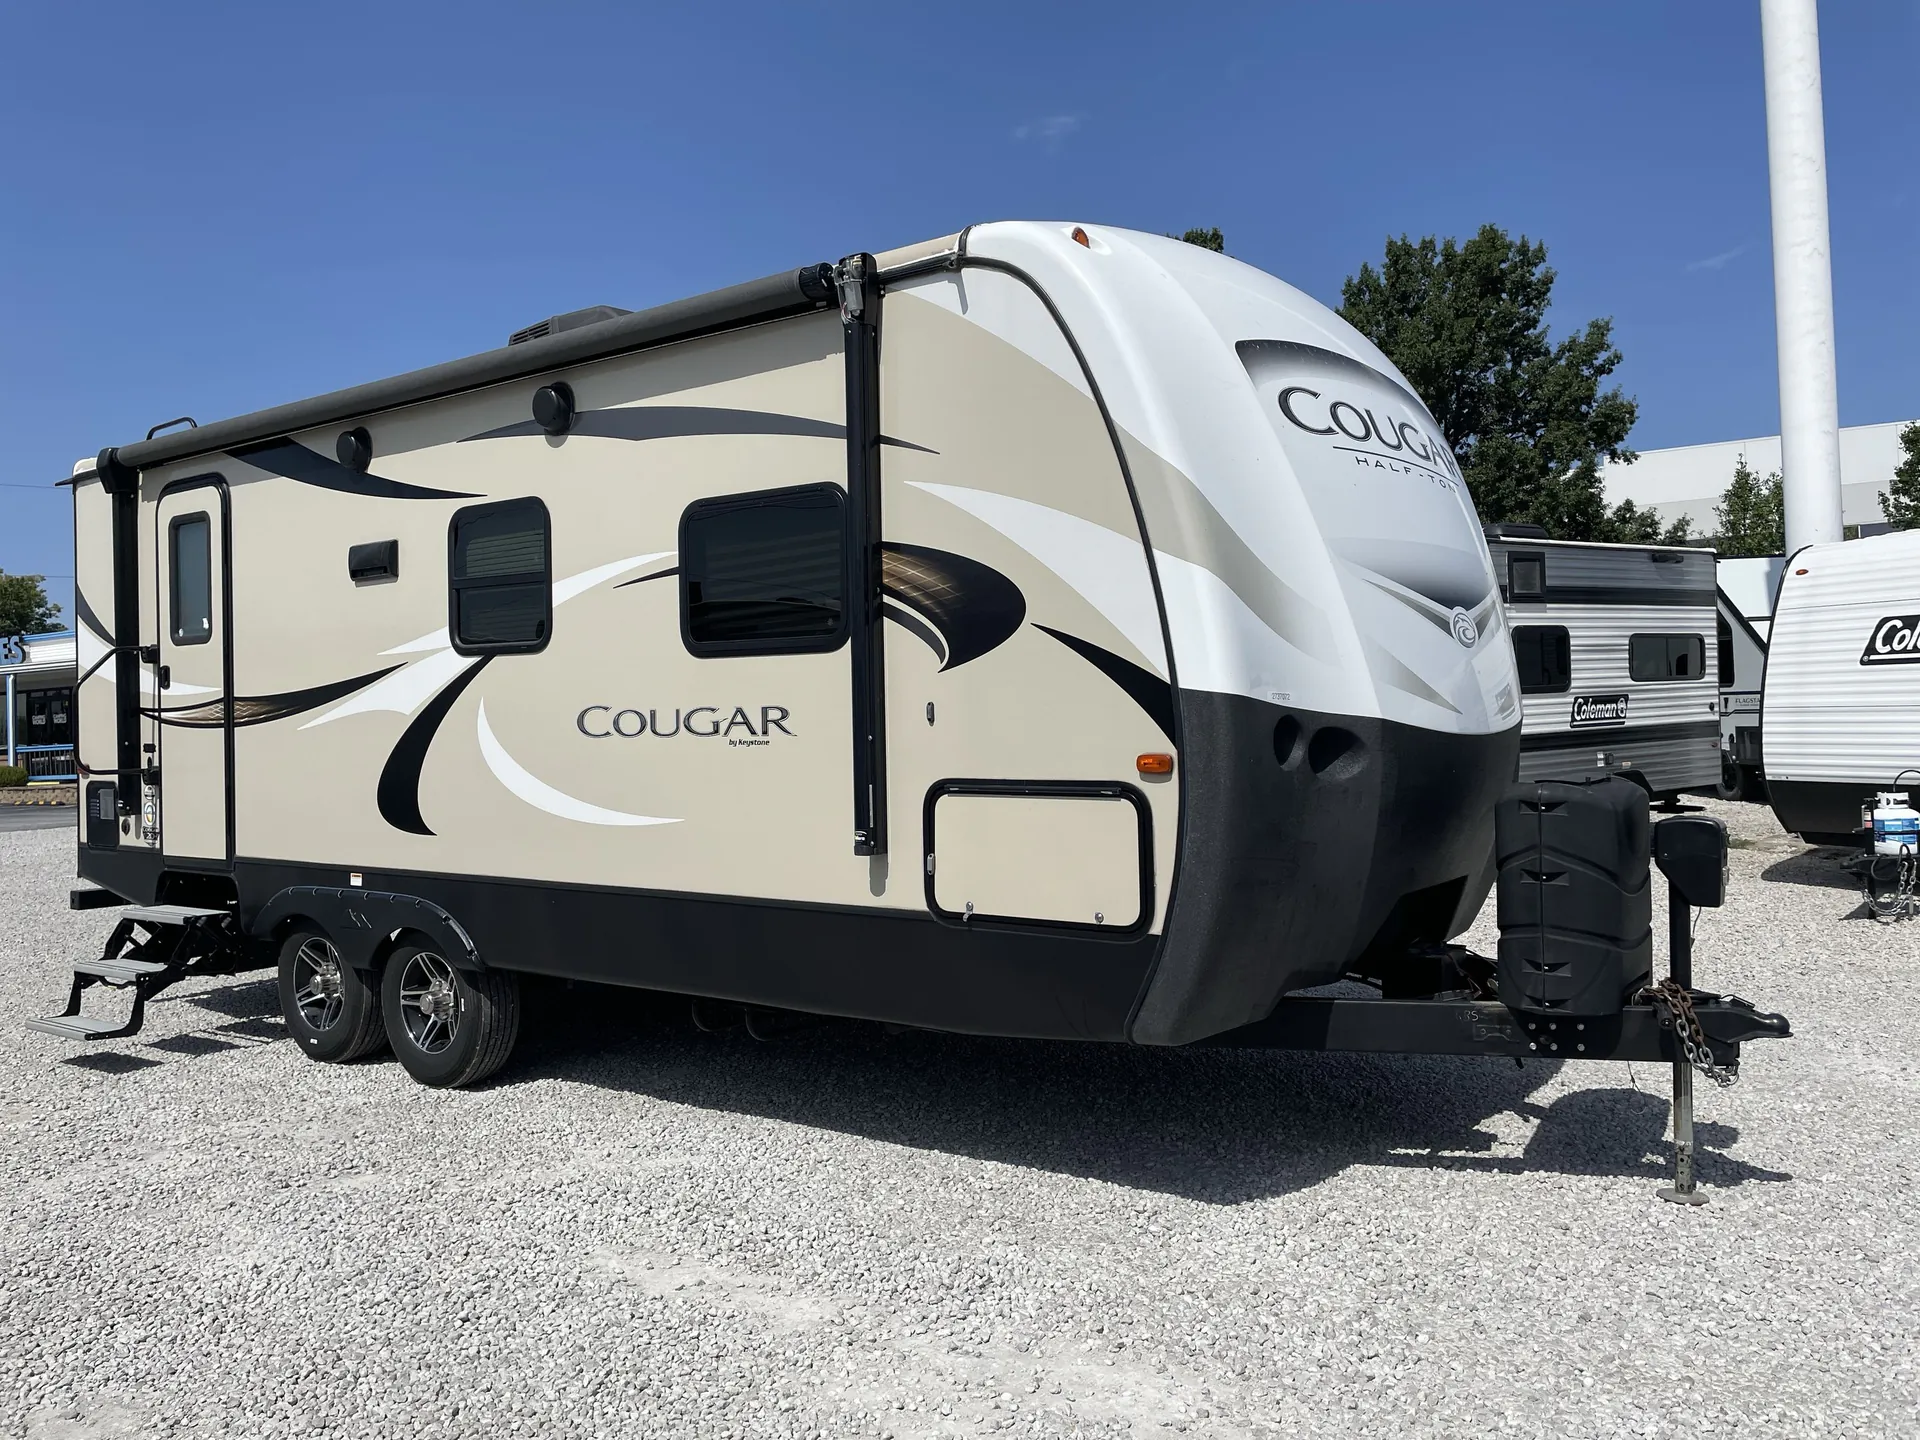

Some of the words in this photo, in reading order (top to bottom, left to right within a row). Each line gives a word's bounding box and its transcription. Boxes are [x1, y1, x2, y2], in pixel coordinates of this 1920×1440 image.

[1278, 386, 1463, 480] COUGAR
[577, 705, 797, 738] COUGAR
[1574, 698, 1617, 721] Coleman
[728, 739, 737, 747] by
[738, 739, 770, 747] Keystone
